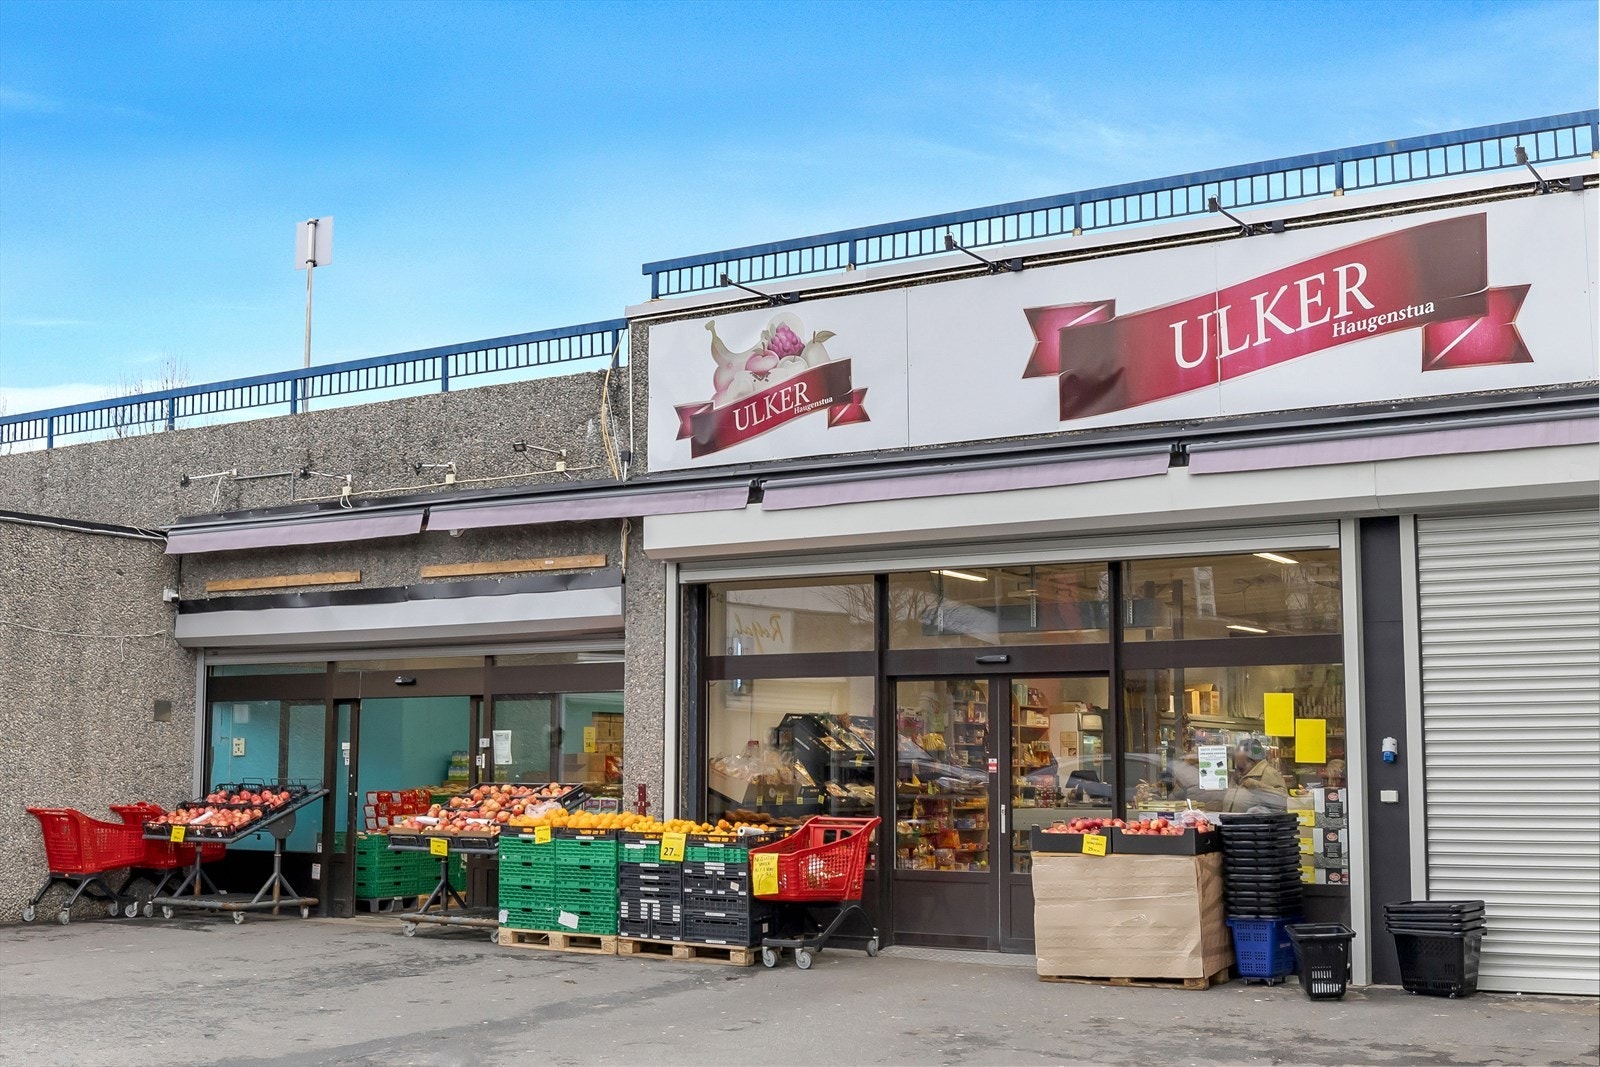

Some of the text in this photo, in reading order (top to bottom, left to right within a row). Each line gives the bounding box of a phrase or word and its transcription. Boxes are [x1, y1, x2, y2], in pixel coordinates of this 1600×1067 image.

[1169, 262, 1375, 370] ULKER
[1332, 301, 1435, 338] Haugenstua
[732, 381, 811, 431] ULKER
[793, 396, 833, 415] Haugenstua
[663, 846, 674, 856] 27
